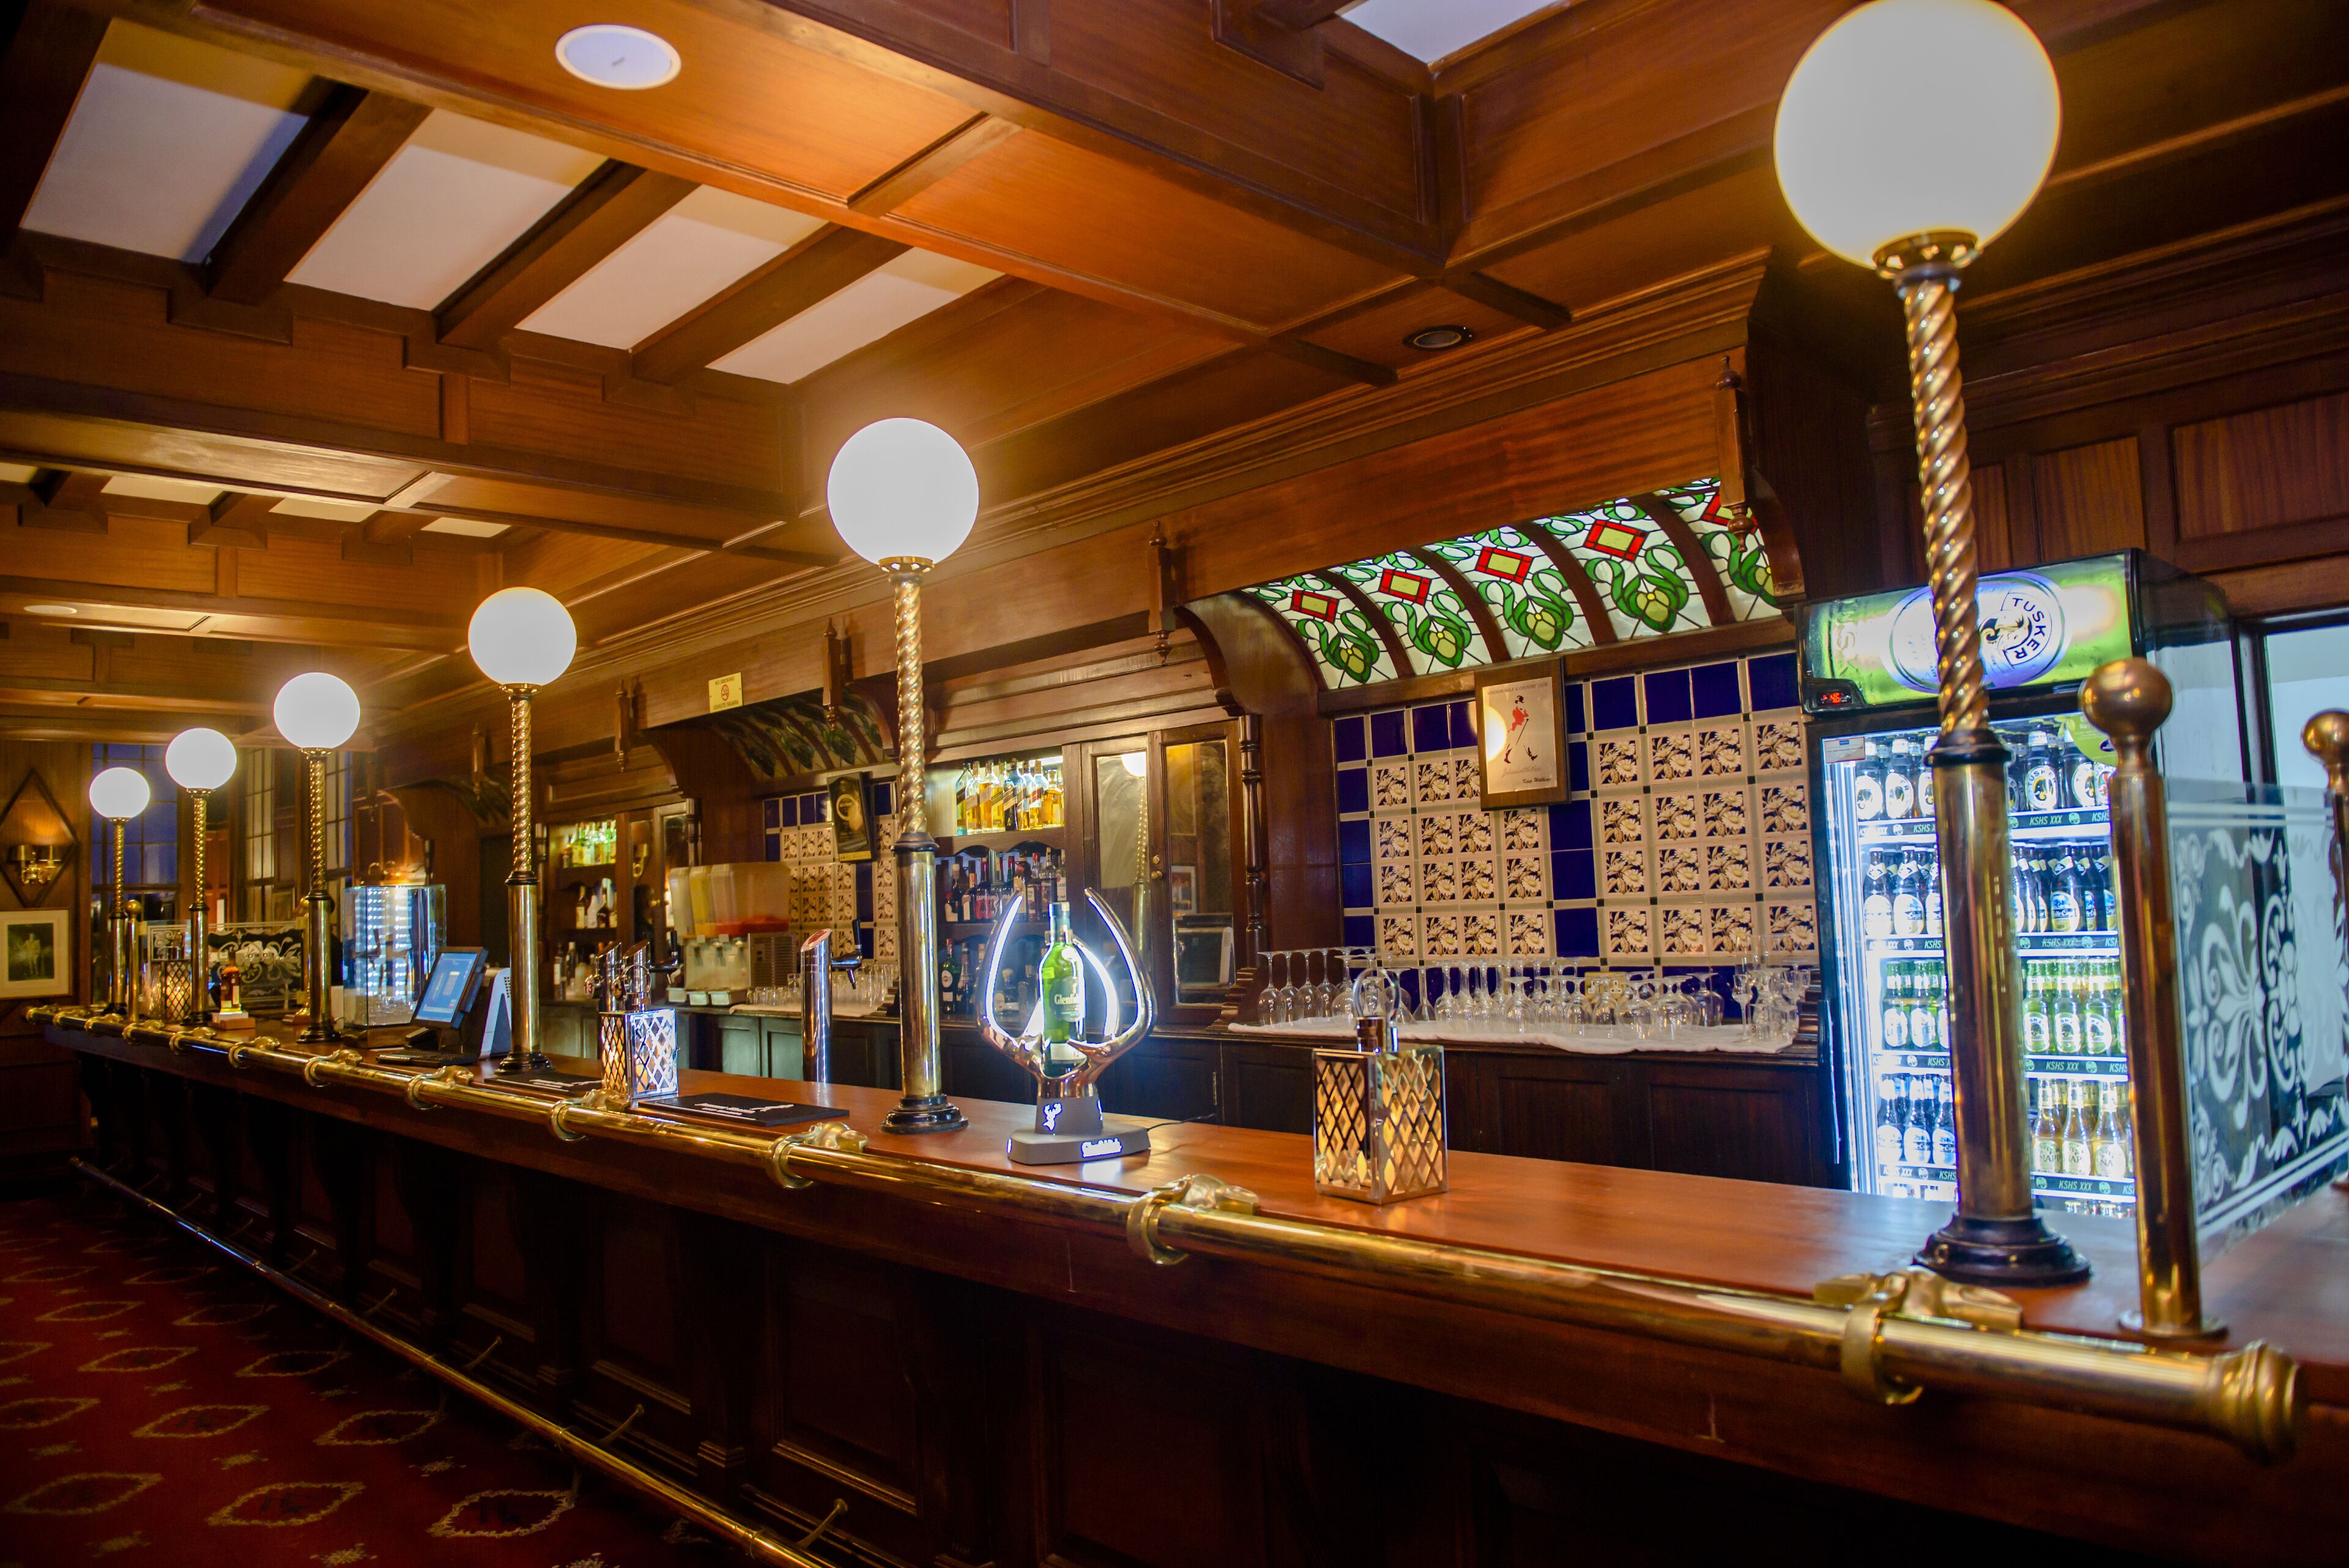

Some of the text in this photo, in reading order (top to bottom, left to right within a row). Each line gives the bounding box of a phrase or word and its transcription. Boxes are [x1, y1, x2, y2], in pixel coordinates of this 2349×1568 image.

[2012, 597, 2046, 659] TUSKER
[2030, 815, 2063, 825] KSHS XXX
[1913, 824, 1931, 833] KSHS
[1924, 940, 1942, 949] KSHS
[2042, 938, 2075, 947] KSHS XXX
[1054, 994, 1078, 1005] Glenfi
[1928, 1057, 1945, 1066] KSHS
[2046, 1061, 2079, 1071] KSHS XXX
[2039, 1154, 2061, 1162] NAPP
[1939, 1170, 1956, 1180] KSHS
[2058, 1180, 2092, 1191] KSHS XXX
